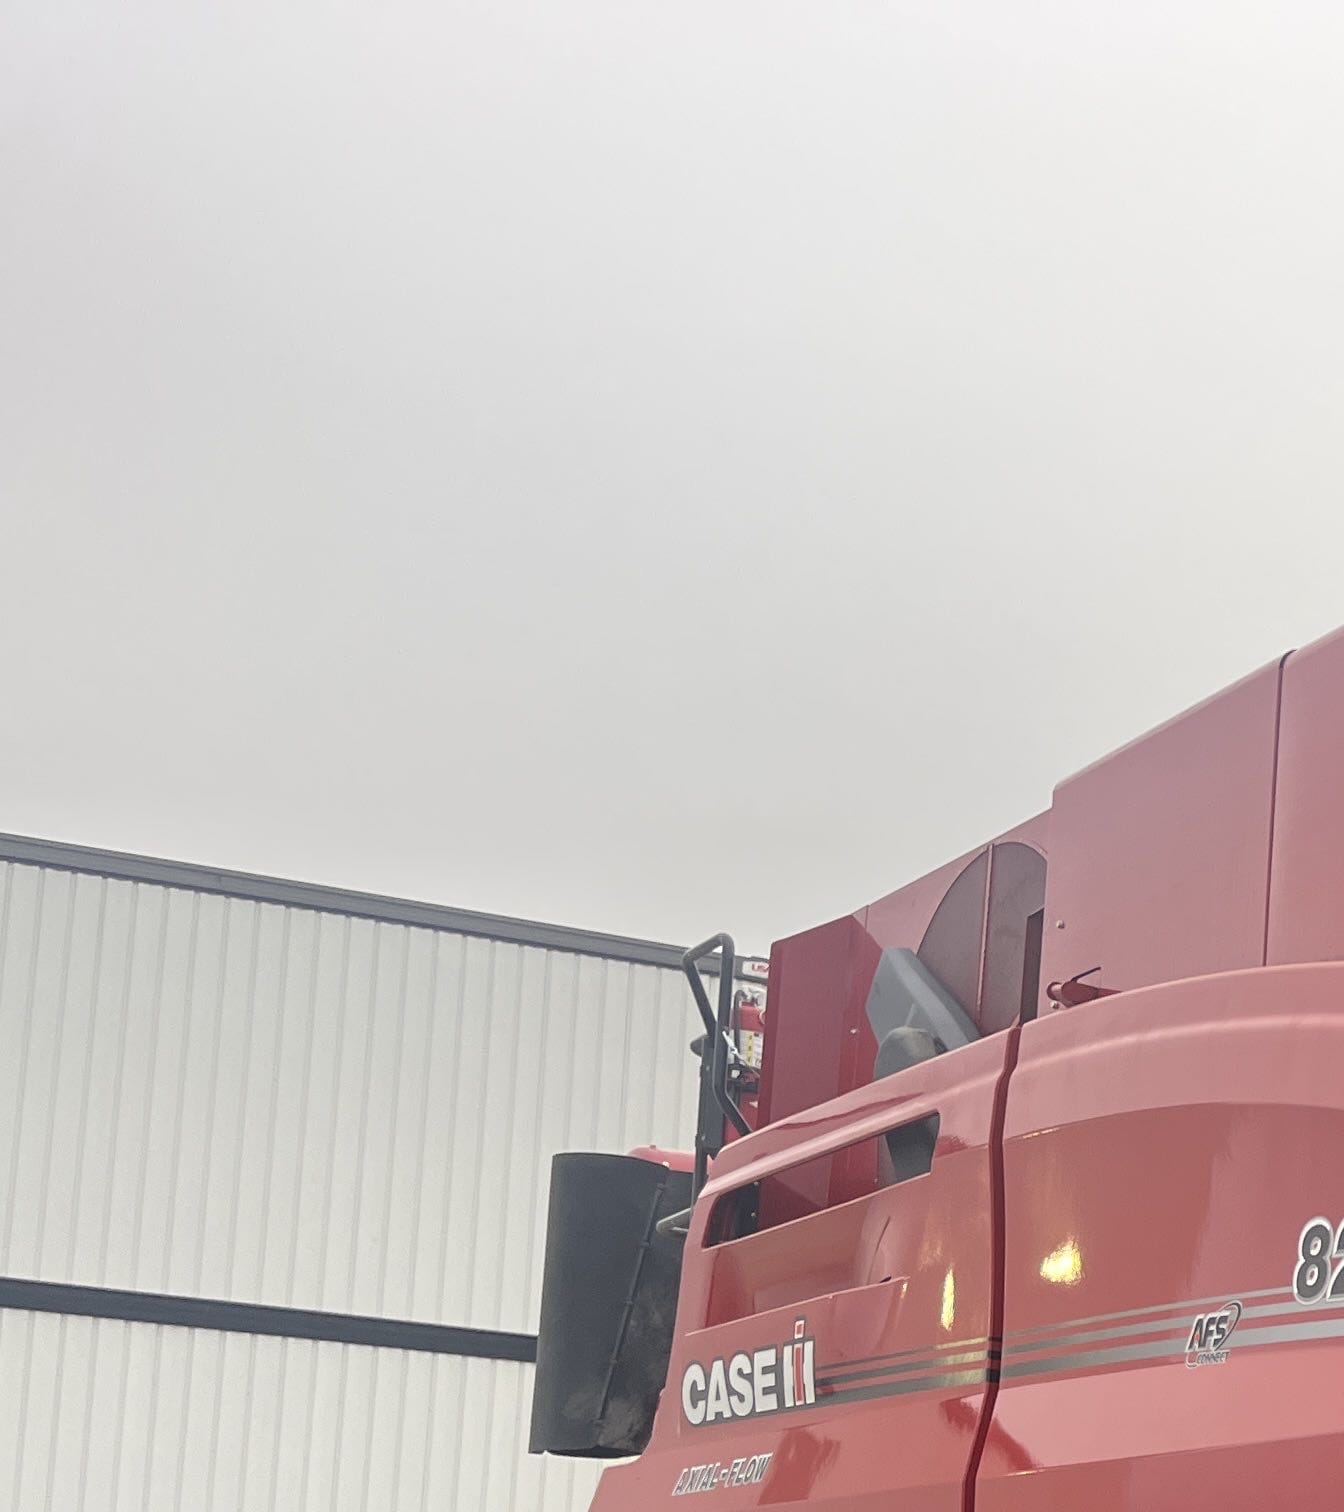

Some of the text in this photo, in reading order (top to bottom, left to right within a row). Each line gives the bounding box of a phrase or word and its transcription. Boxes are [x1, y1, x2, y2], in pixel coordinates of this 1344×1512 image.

[1185, 1311, 1230, 1352] AFS
[1197, 1351, 1230, 1363] CONNECT
[681, 1348, 779, 1425] CASE
[671, 1452, 774, 1497] AXIAL-FLOW
